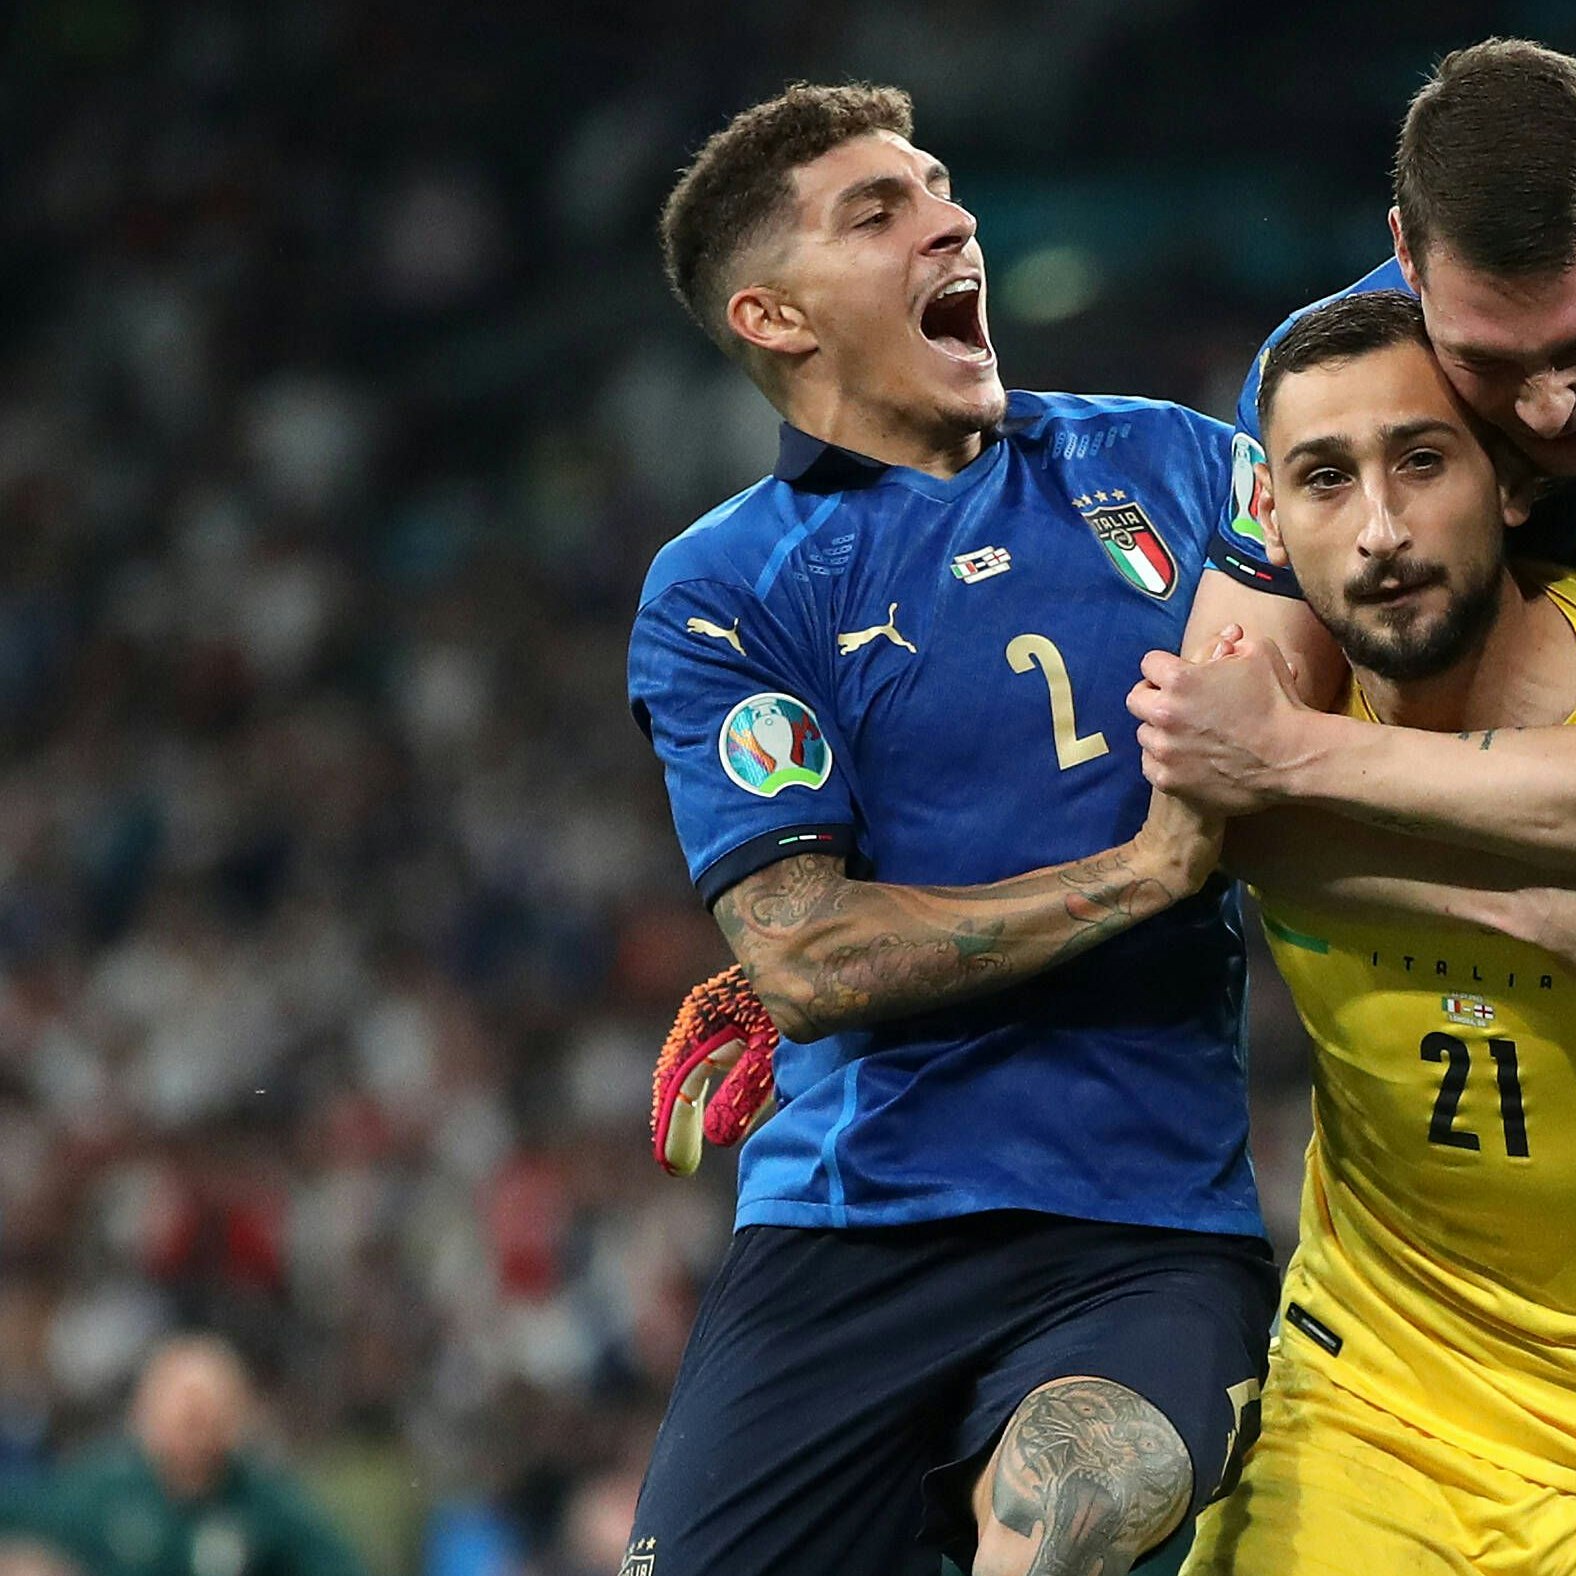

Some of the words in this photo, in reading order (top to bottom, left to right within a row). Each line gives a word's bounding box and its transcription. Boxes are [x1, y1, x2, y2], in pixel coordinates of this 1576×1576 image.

[1091, 511, 1140, 532] TALIA
[1005, 633, 1110, 771] 2
[1371, 951, 1553, 989] ITALIA
[1420, 1031, 1530, 1158] 21
